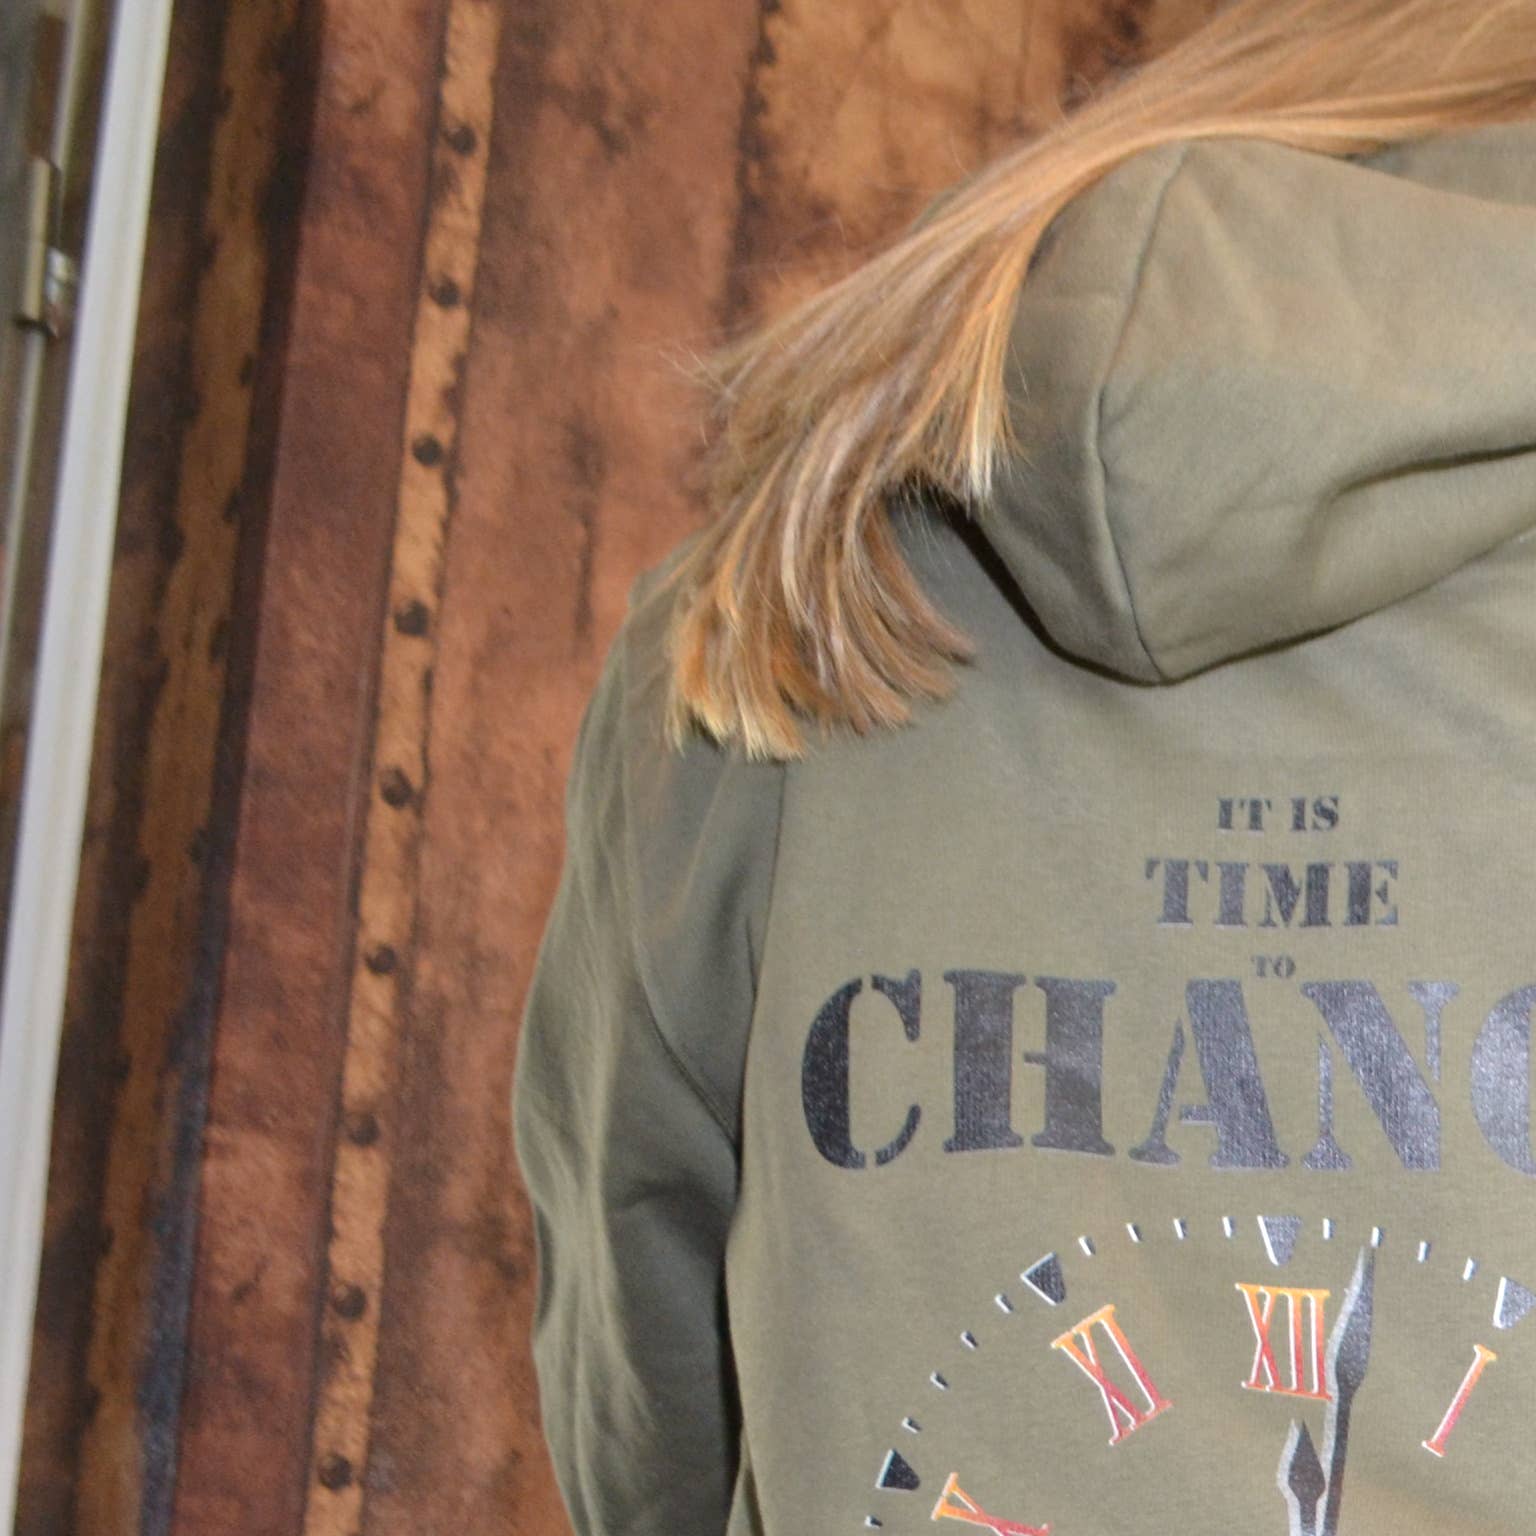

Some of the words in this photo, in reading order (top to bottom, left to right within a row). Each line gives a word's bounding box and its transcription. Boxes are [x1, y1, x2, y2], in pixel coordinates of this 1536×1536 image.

[1216, 796, 1273, 832] IT
[1289, 794, 1341, 832] IS
[1144, 857, 1400, 929] TIME
[1250, 955, 1298, 979] TO
[1051, 1304, 1174, 1445] XI
[1234, 1282, 1334, 1402] XII
